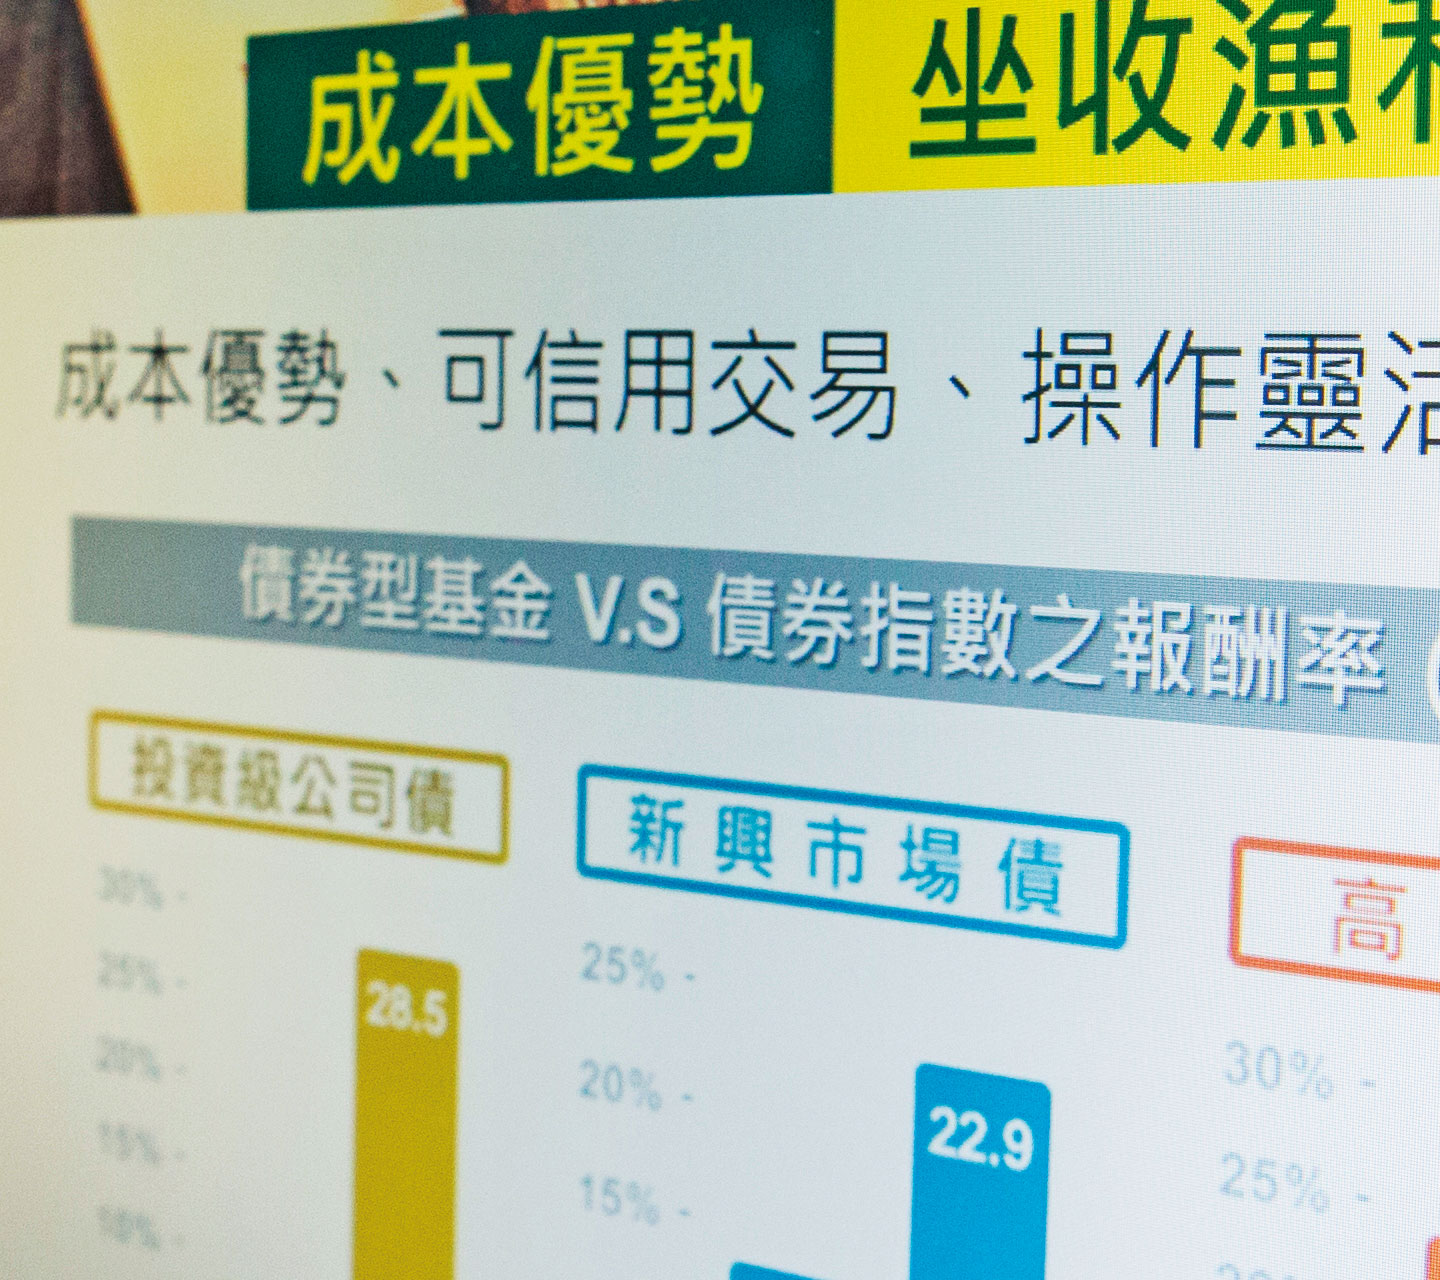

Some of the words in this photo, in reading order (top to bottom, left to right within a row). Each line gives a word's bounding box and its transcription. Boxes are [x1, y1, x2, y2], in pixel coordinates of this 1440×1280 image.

[300, 22, 765, 188] 成本優勢
[239, 543, 552, 641] 債券型基金
[131, 733, 455, 838] 投資級公司債
[627, 791, 1066, 918] 新興市場債
[581, 941, 664, 993] 25%
[365, 980, 450, 1037] 28.5
[579, 1058, 662, 1111] 20%
[1223, 1040, 1335, 1100] 30%
[927, 1105, 1036, 1172] 22.9
[580, 1174, 660, 1226] 15%
[1219, 1152, 1332, 1214] 25%
